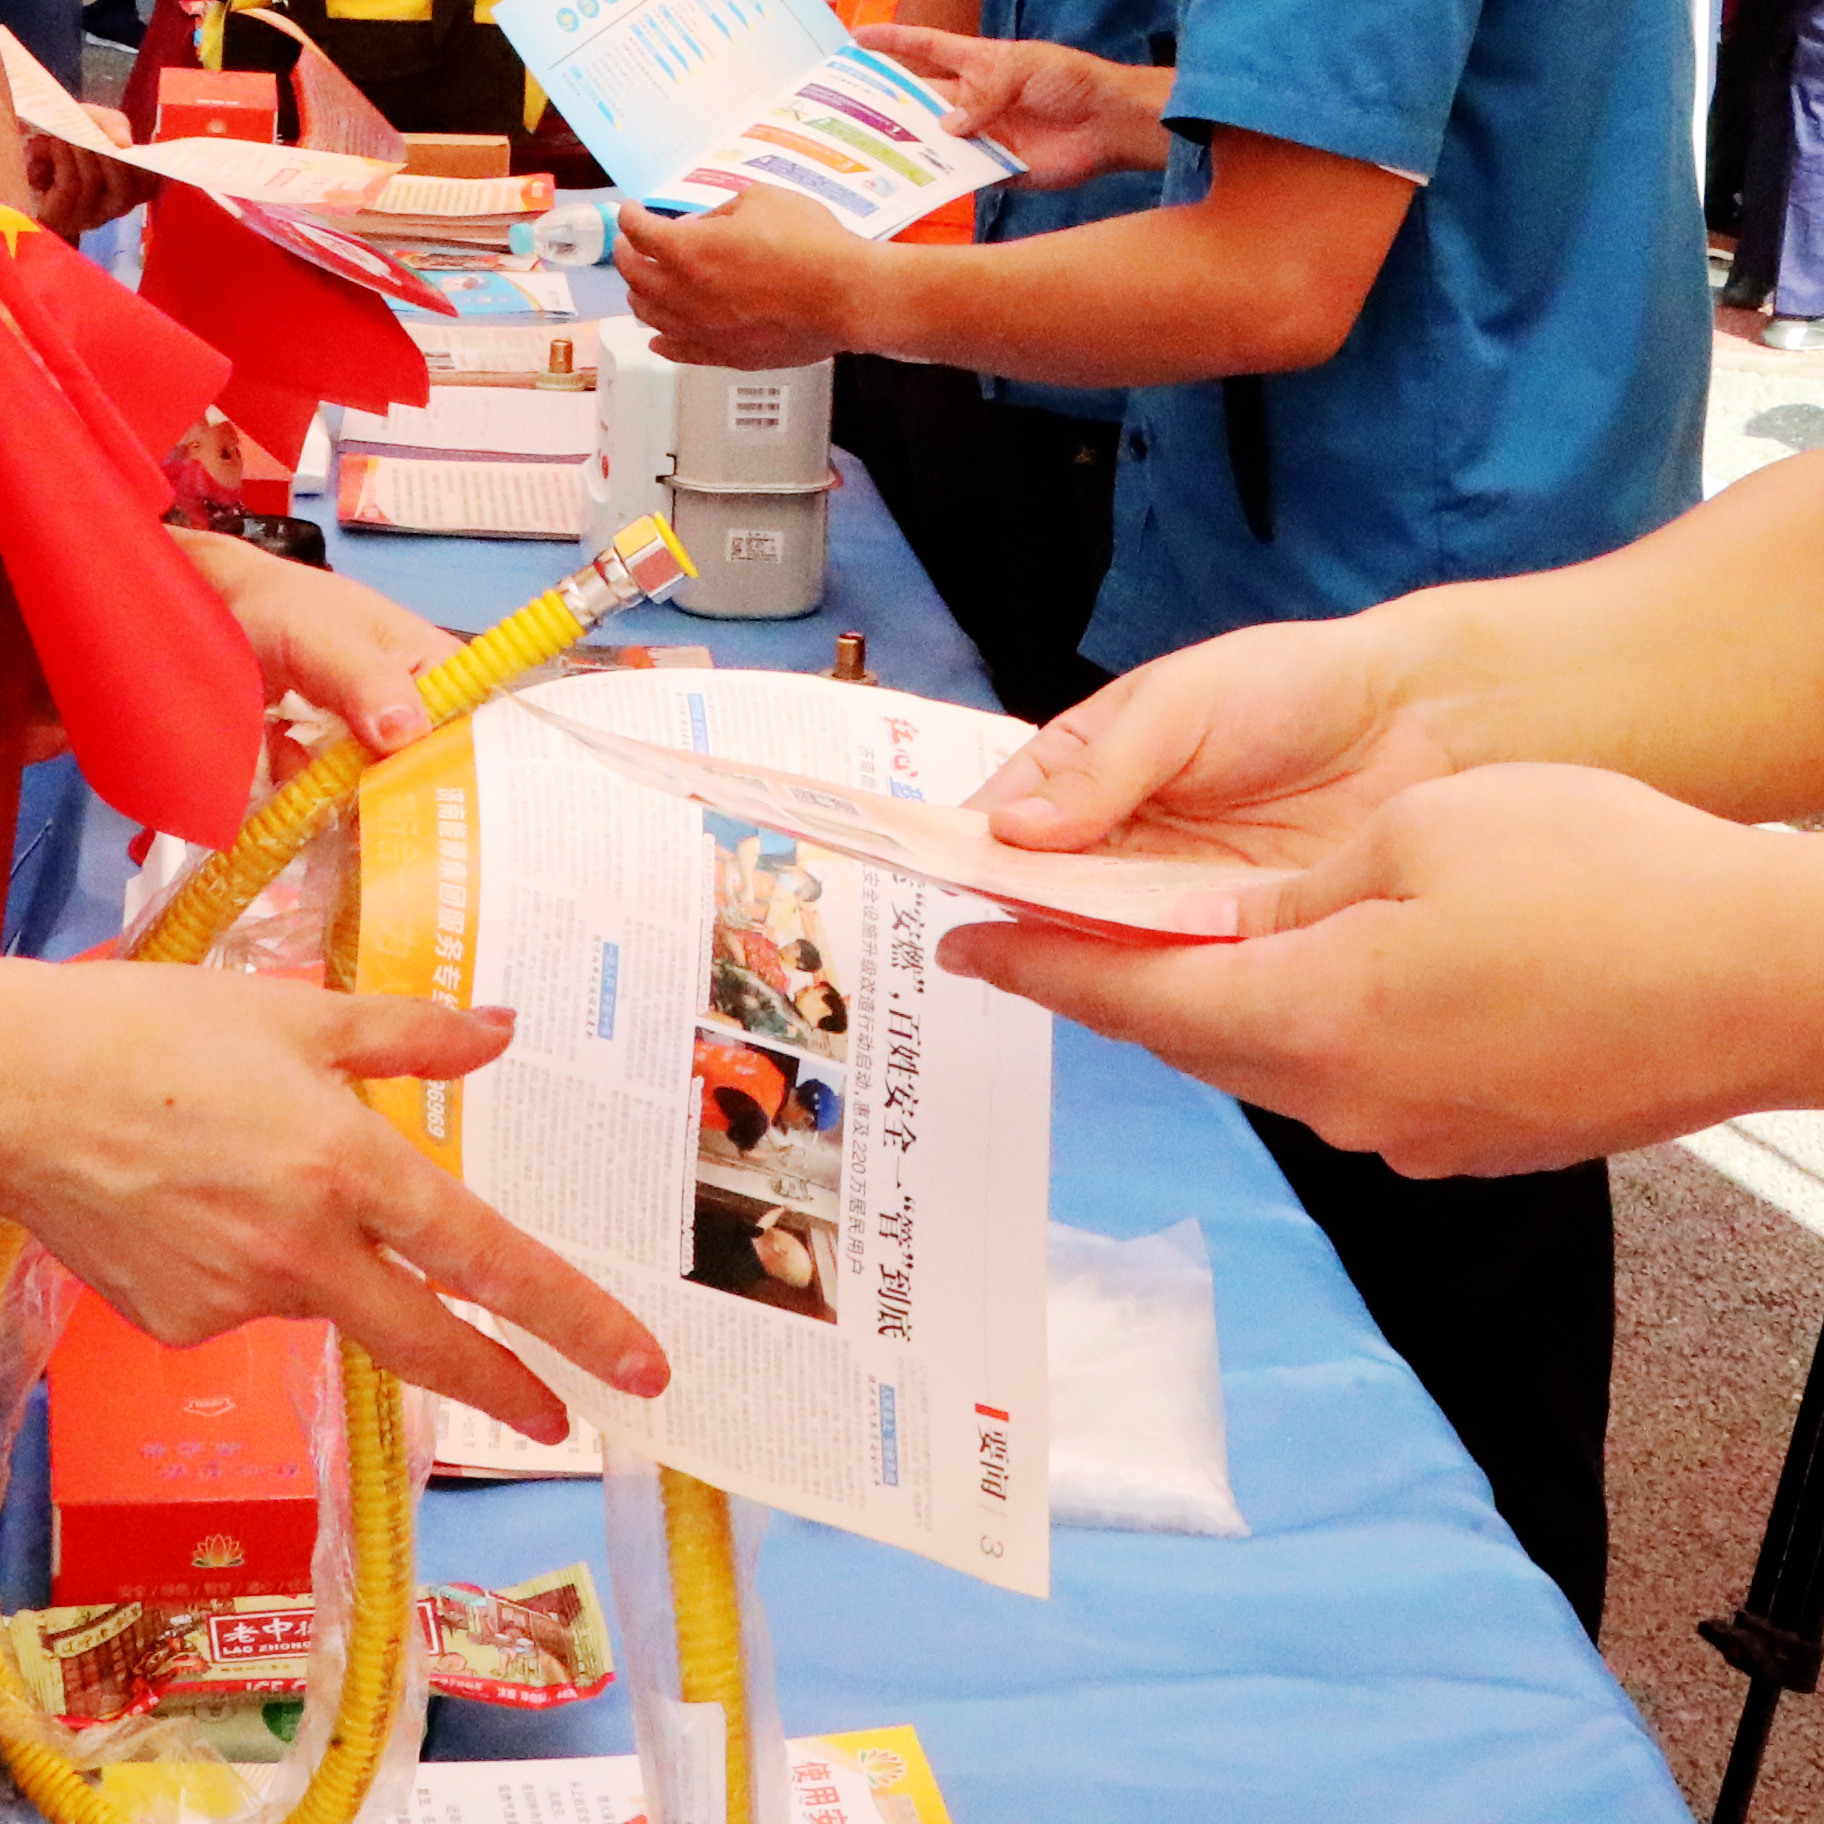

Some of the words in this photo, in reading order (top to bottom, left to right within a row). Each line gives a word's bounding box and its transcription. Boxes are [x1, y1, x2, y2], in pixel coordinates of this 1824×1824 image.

[846, 863, 878, 1275] 安全设施升级改造行动启动,惠及220万居民用户
[975, 1424, 1010, 1502] 要闻
[980, 1535, 1004, 1560] 3
